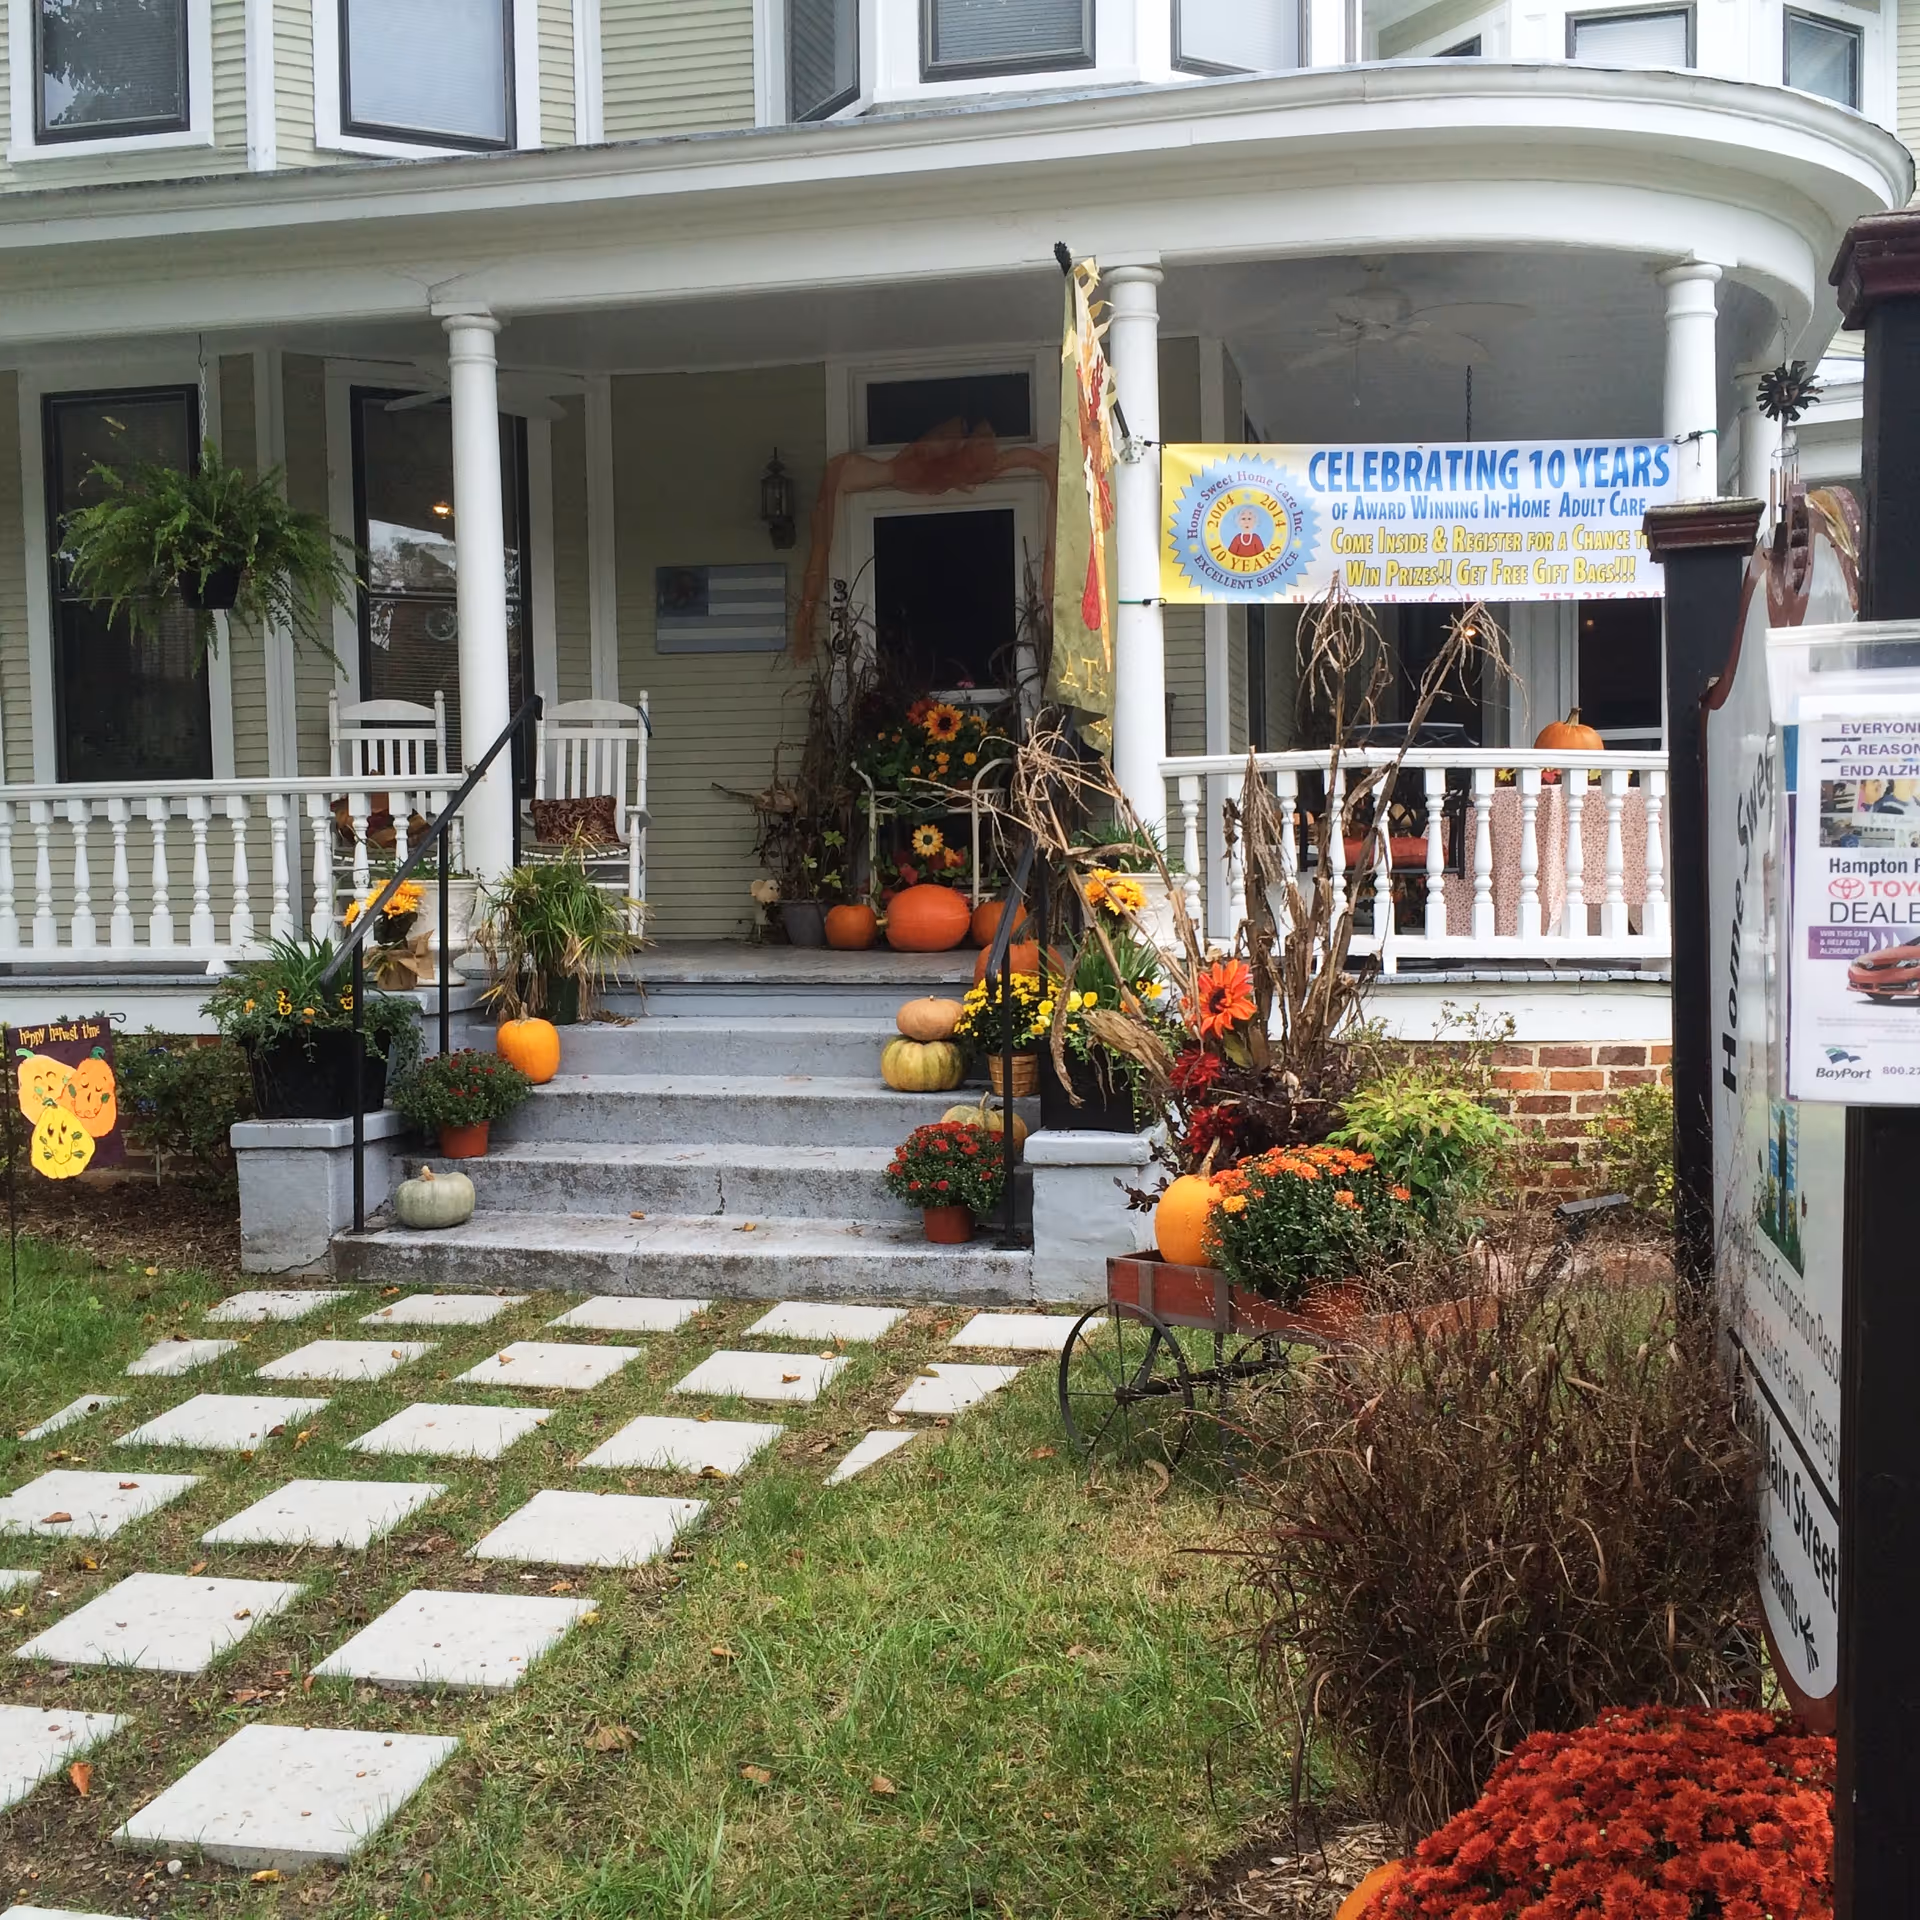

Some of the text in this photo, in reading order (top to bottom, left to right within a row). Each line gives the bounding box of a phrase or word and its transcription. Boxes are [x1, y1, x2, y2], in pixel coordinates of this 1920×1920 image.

[1309, 445, 1670, 492] CELEBRATING 10 YEARS
[1187, 471, 1304, 539] Home Sweet Home Care Inc.
[1207, 493, 1235, 528] 2004
[1260, 493, 1287, 527] 2014
[1432, 525, 1448, 554] &
[1194, 551, 1299, 589] EXCELLENT SERVICE
[1210, 543, 1282, 572] 10 YEARS
[1841, 722, 1920, 734] EVERYON
[1841, 744, 1852, 756] A
[1840, 764, 1920, 777] END ALZH
[1829, 857, 1908, 877] Hampton
[1868, 880, 1920, 897] TOY
[1722, 878, 1744, 1094] Home
[18, 1021, 100, 1048] happy harvest time
[1815, 1067, 1872, 1080] BayPort
[1784, 1349, 1808, 1436] Family
[1793, 1471, 1838, 1614] Street
